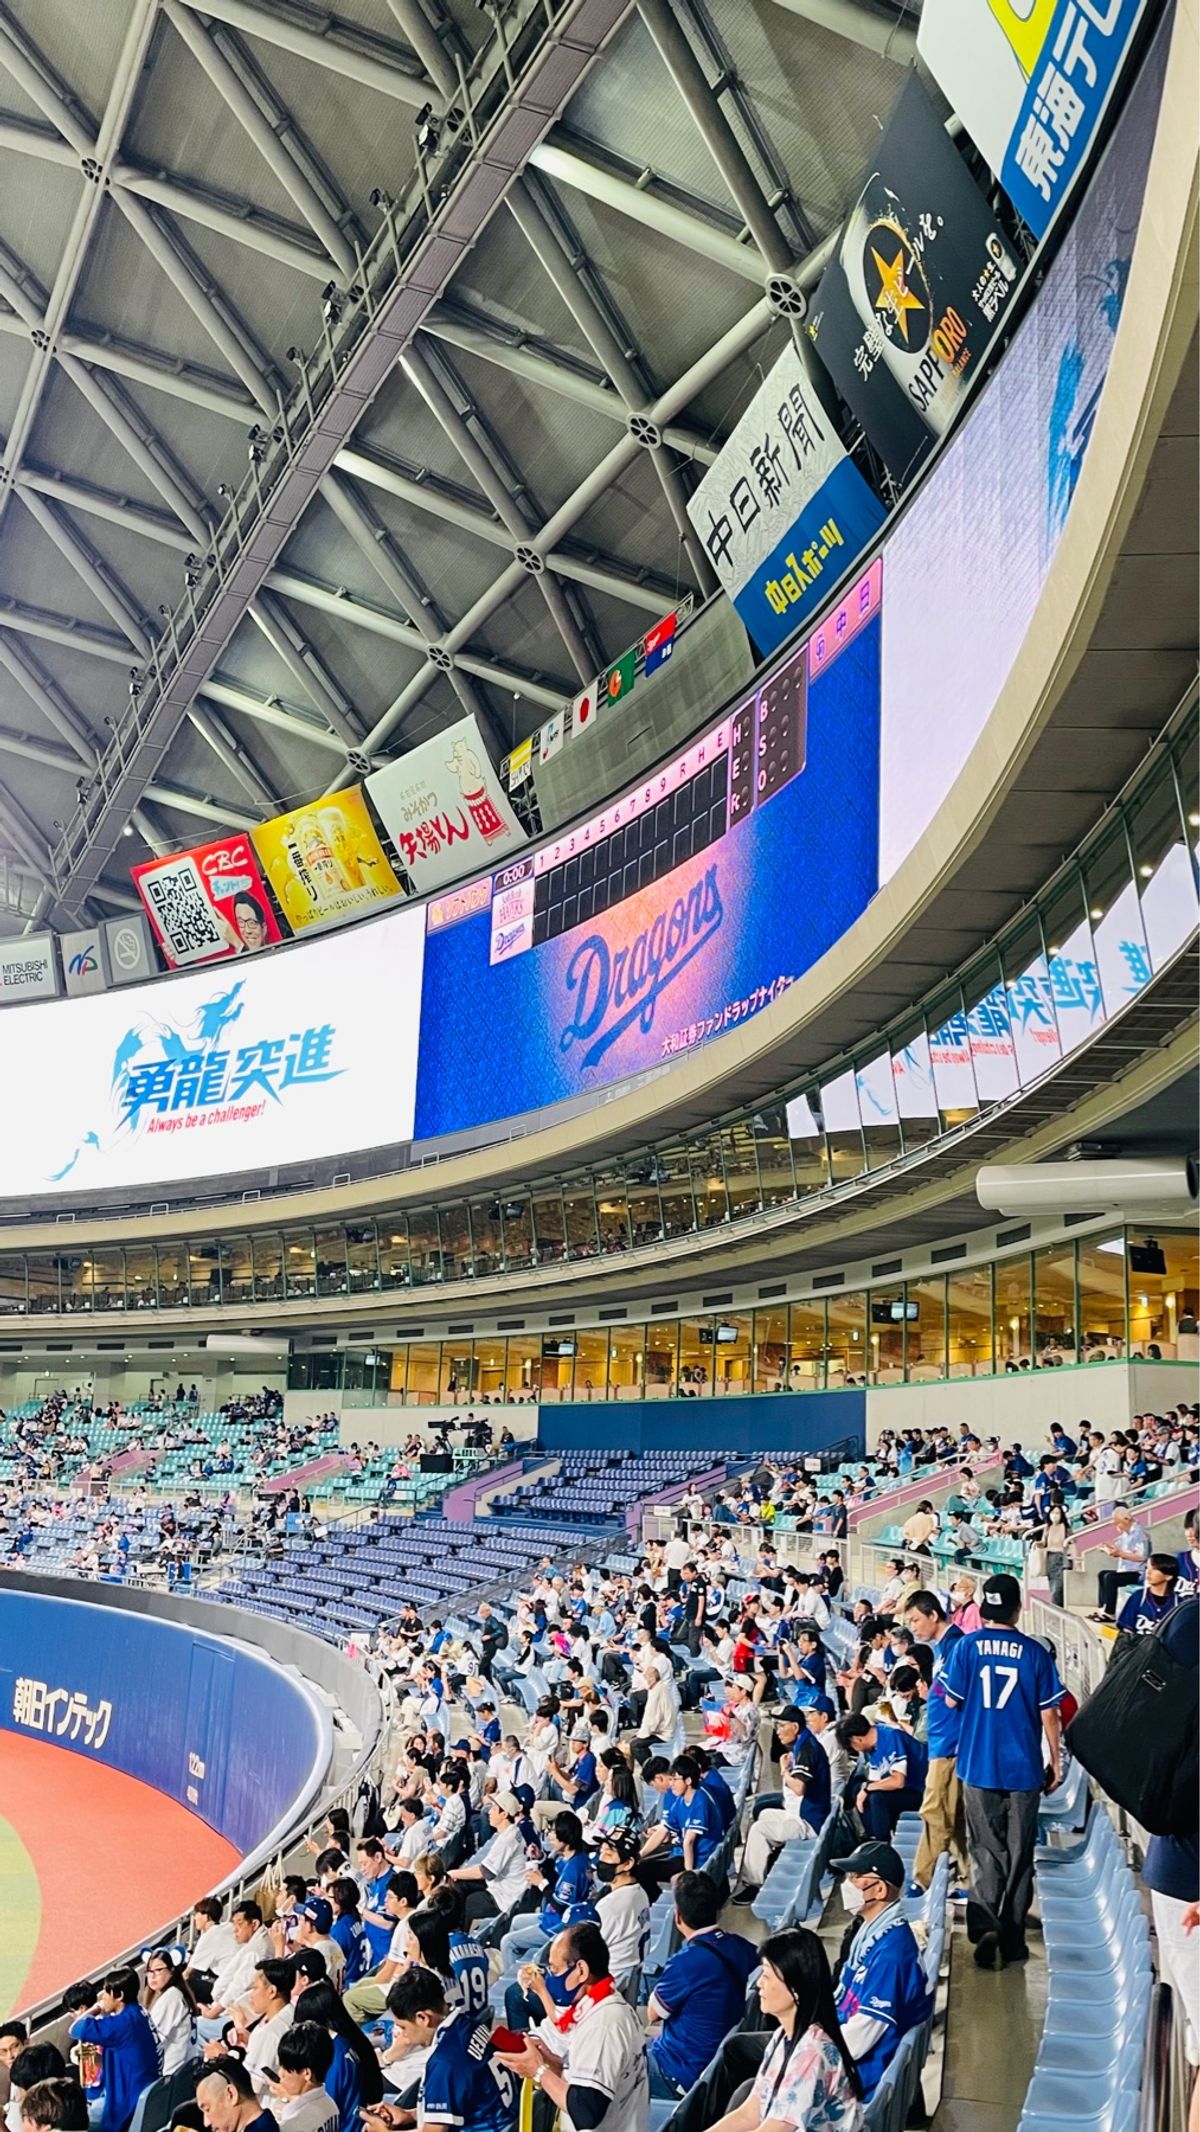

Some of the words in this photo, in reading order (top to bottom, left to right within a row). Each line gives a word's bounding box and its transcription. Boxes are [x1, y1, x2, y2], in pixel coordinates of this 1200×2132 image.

[908, 306, 968, 412] SAPPORO
[706, 383, 825, 568] 中日新聞
[764, 517, 844, 614] 中日スポーツ
[760, 700, 768, 723] B
[733, 723, 742, 747] H
[759, 734, 767, 757] S
[732, 757, 741, 780] E
[401, 792, 438, 822] みそかつ
[540, 855, 544, 867] 1
[554, 847, 560, 860] 2
[569, 838, 575, 851] 3
[584, 828, 590, 842] 4
[599, 819, 606, 833] 5
[614, 810, 621, 823] 6
[629, 799, 637, 812] 7
[644, 788, 651, 803] 8
[660, 777, 667, 792] 9
[679, 762, 686, 778] R
[698, 749, 706, 763] H
[717, 731, 724, 748] E
[399, 806, 469, 865] 矢場とん
[201, 846, 249, 875] CBC
[503, 864, 525, 885] 0:00
[2, 958, 48, 974] MITSUBISHI
[4, 971, 43, 986] ELECTRIC
[559, 863, 724, 1072] Dragons
[114, 1023, 350, 1133] 勇龍突進
[147, 1116, 183, 1134] Always
[185, 1112, 197, 1128] be
[199, 1113, 206, 1126] a
[207, 1099, 266, 1125] challenger!
[976, 1639, 1023, 1659] YANAGI
[979, 1664, 1018, 1710] 17
[13, 1677, 112, 1749] 朝日インテック
[459, 1966, 486, 2014] 19
